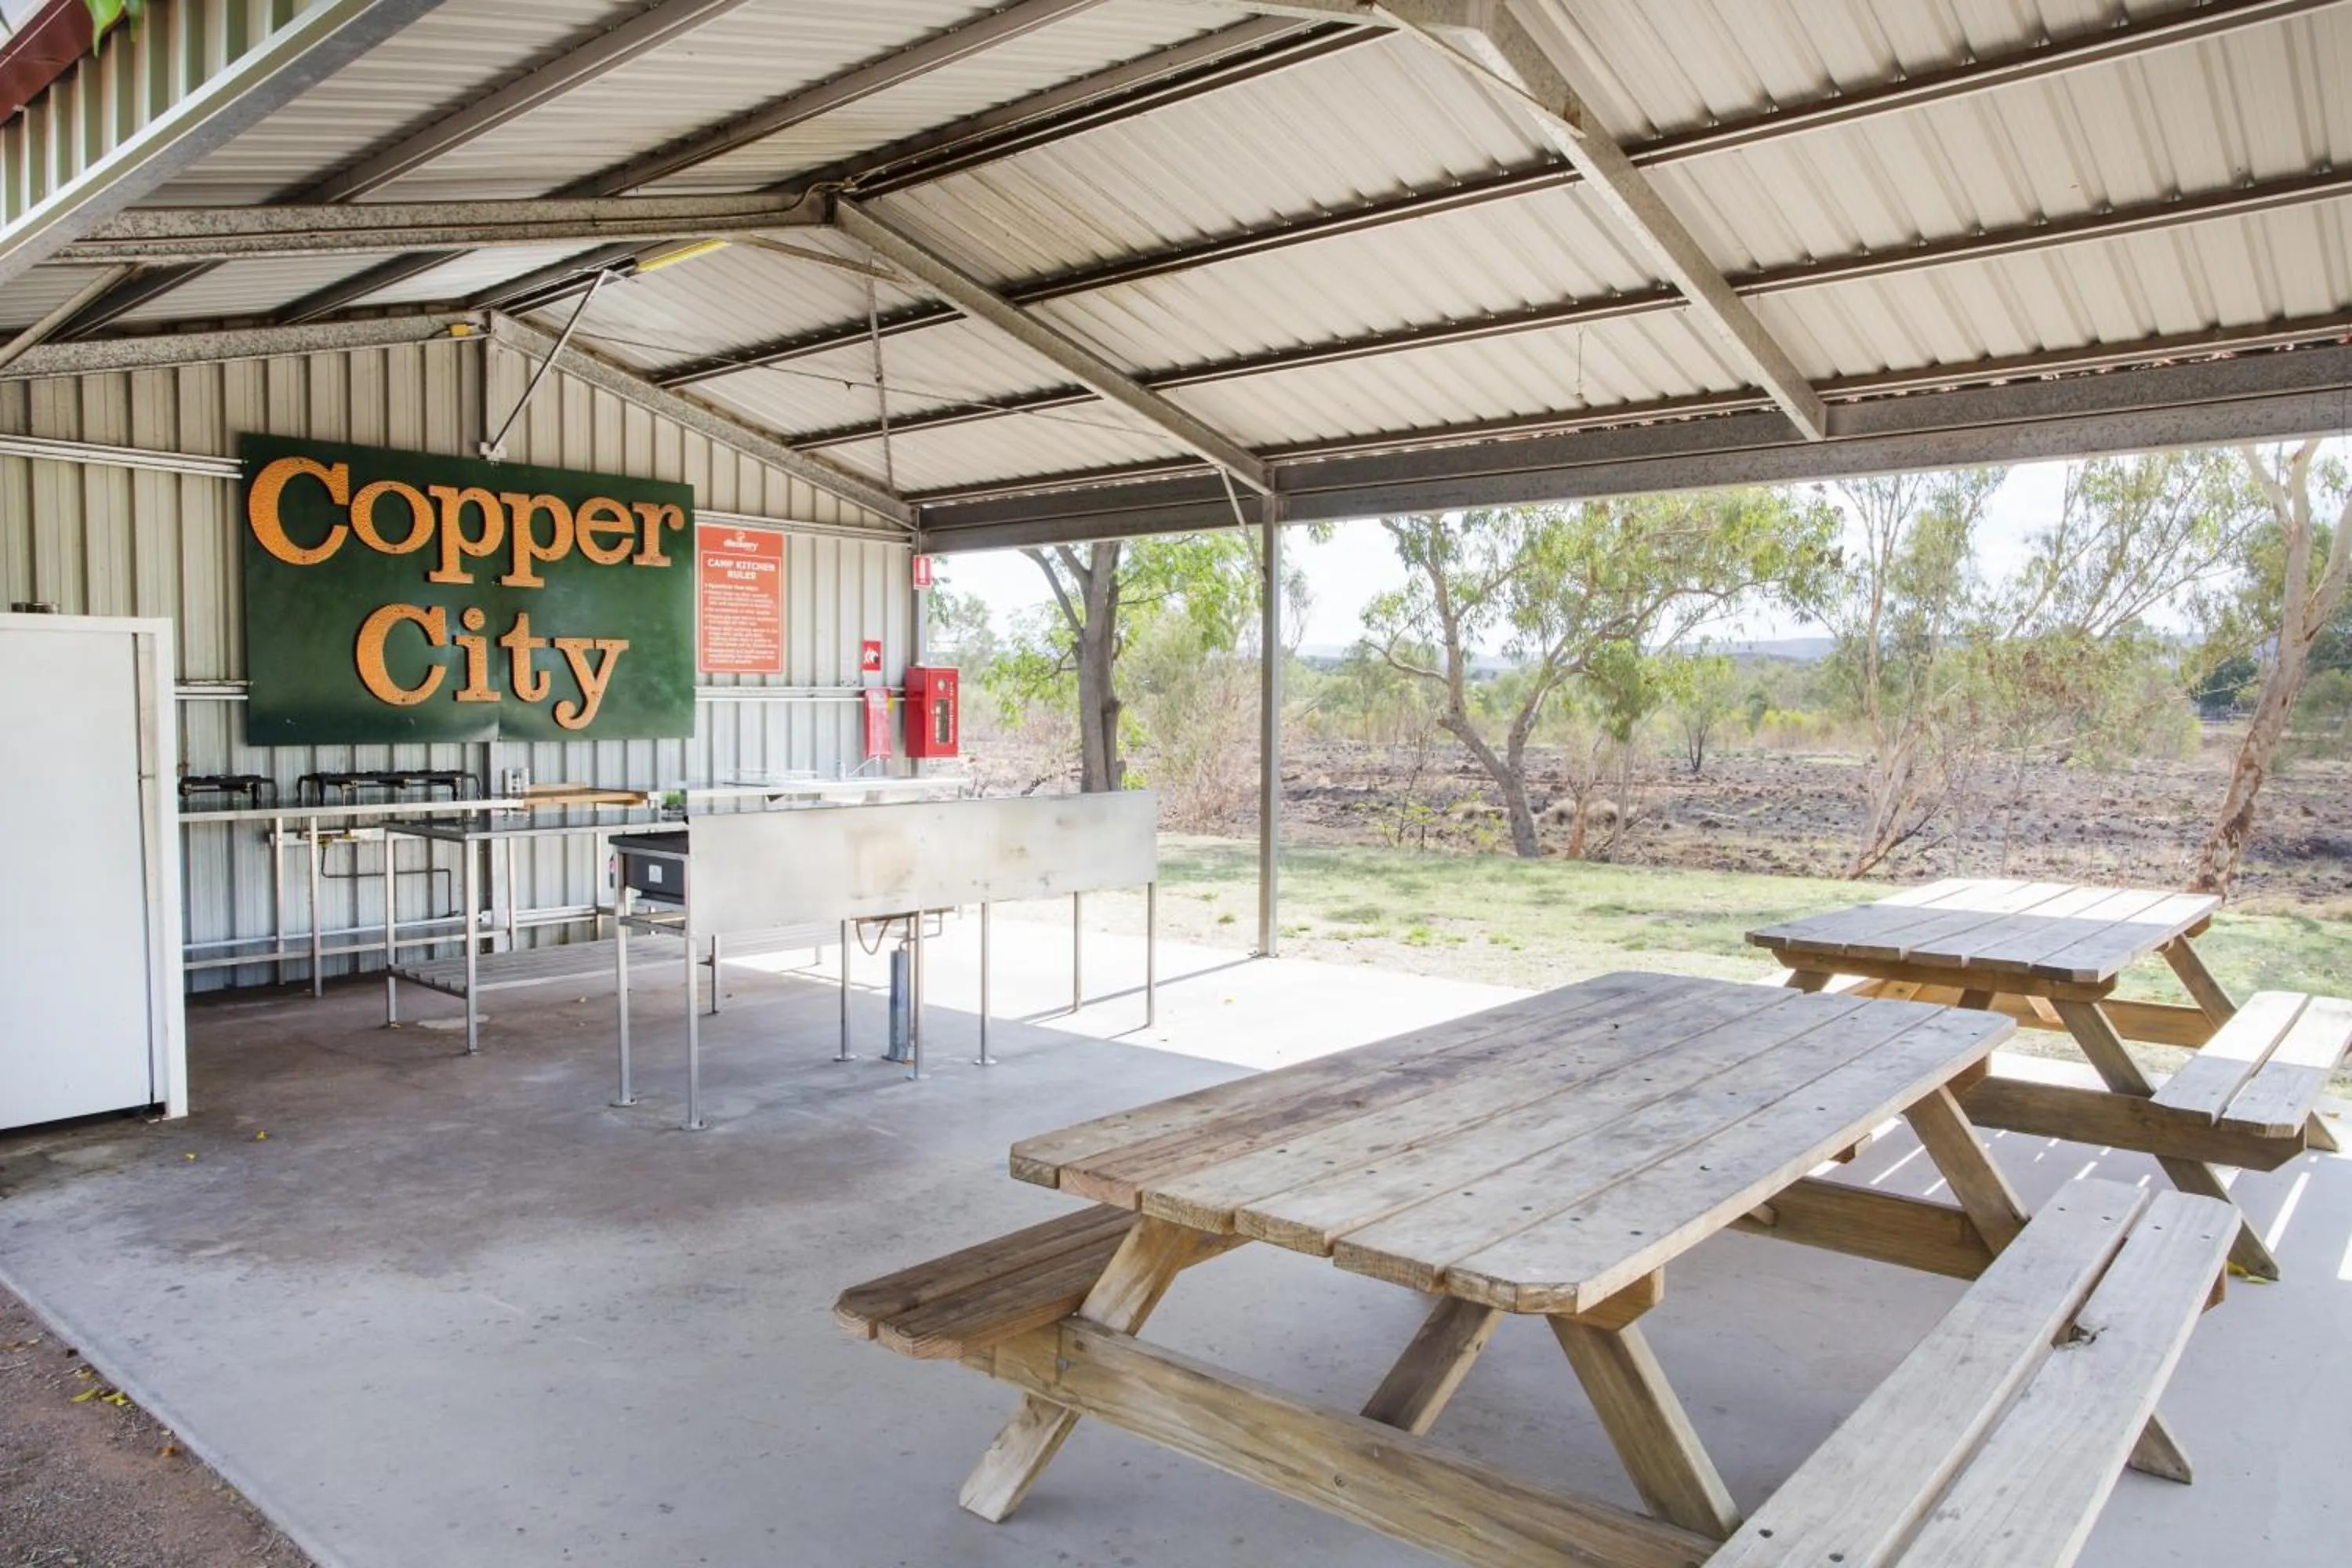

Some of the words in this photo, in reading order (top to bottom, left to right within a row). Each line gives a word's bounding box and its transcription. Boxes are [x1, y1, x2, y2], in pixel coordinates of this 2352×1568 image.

[248, 456, 685, 588] Copper
[708, 558, 734, 568] CAMP
[356, 603, 630, 730] City
